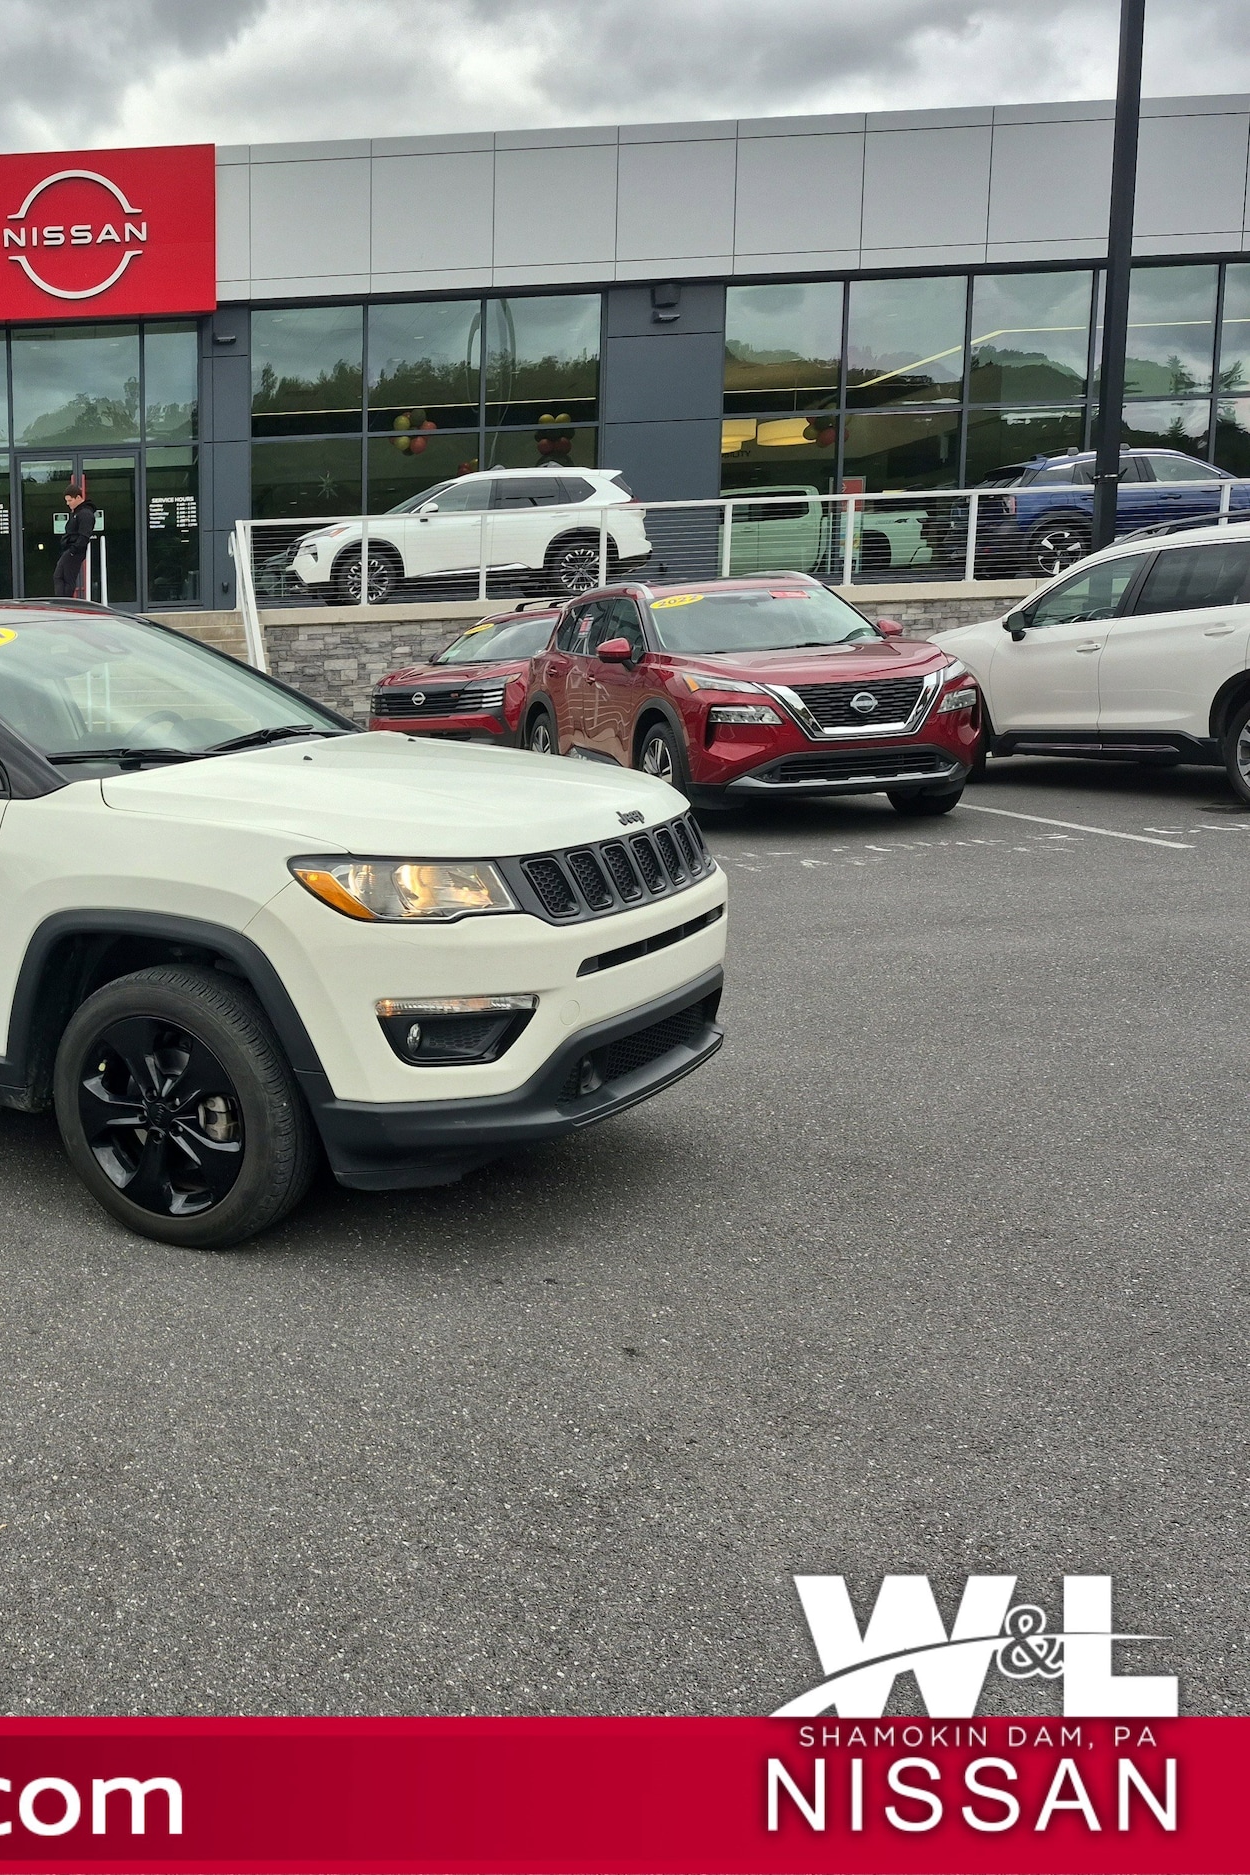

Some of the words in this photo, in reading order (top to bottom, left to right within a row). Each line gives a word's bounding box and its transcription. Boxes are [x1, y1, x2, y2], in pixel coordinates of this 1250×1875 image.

[3, 221, 148, 249] NISSAN
[151, 496, 175, 504] SERVICE
[175, 495, 195, 503] HOURS
[615, 809, 646, 826] Jeep
